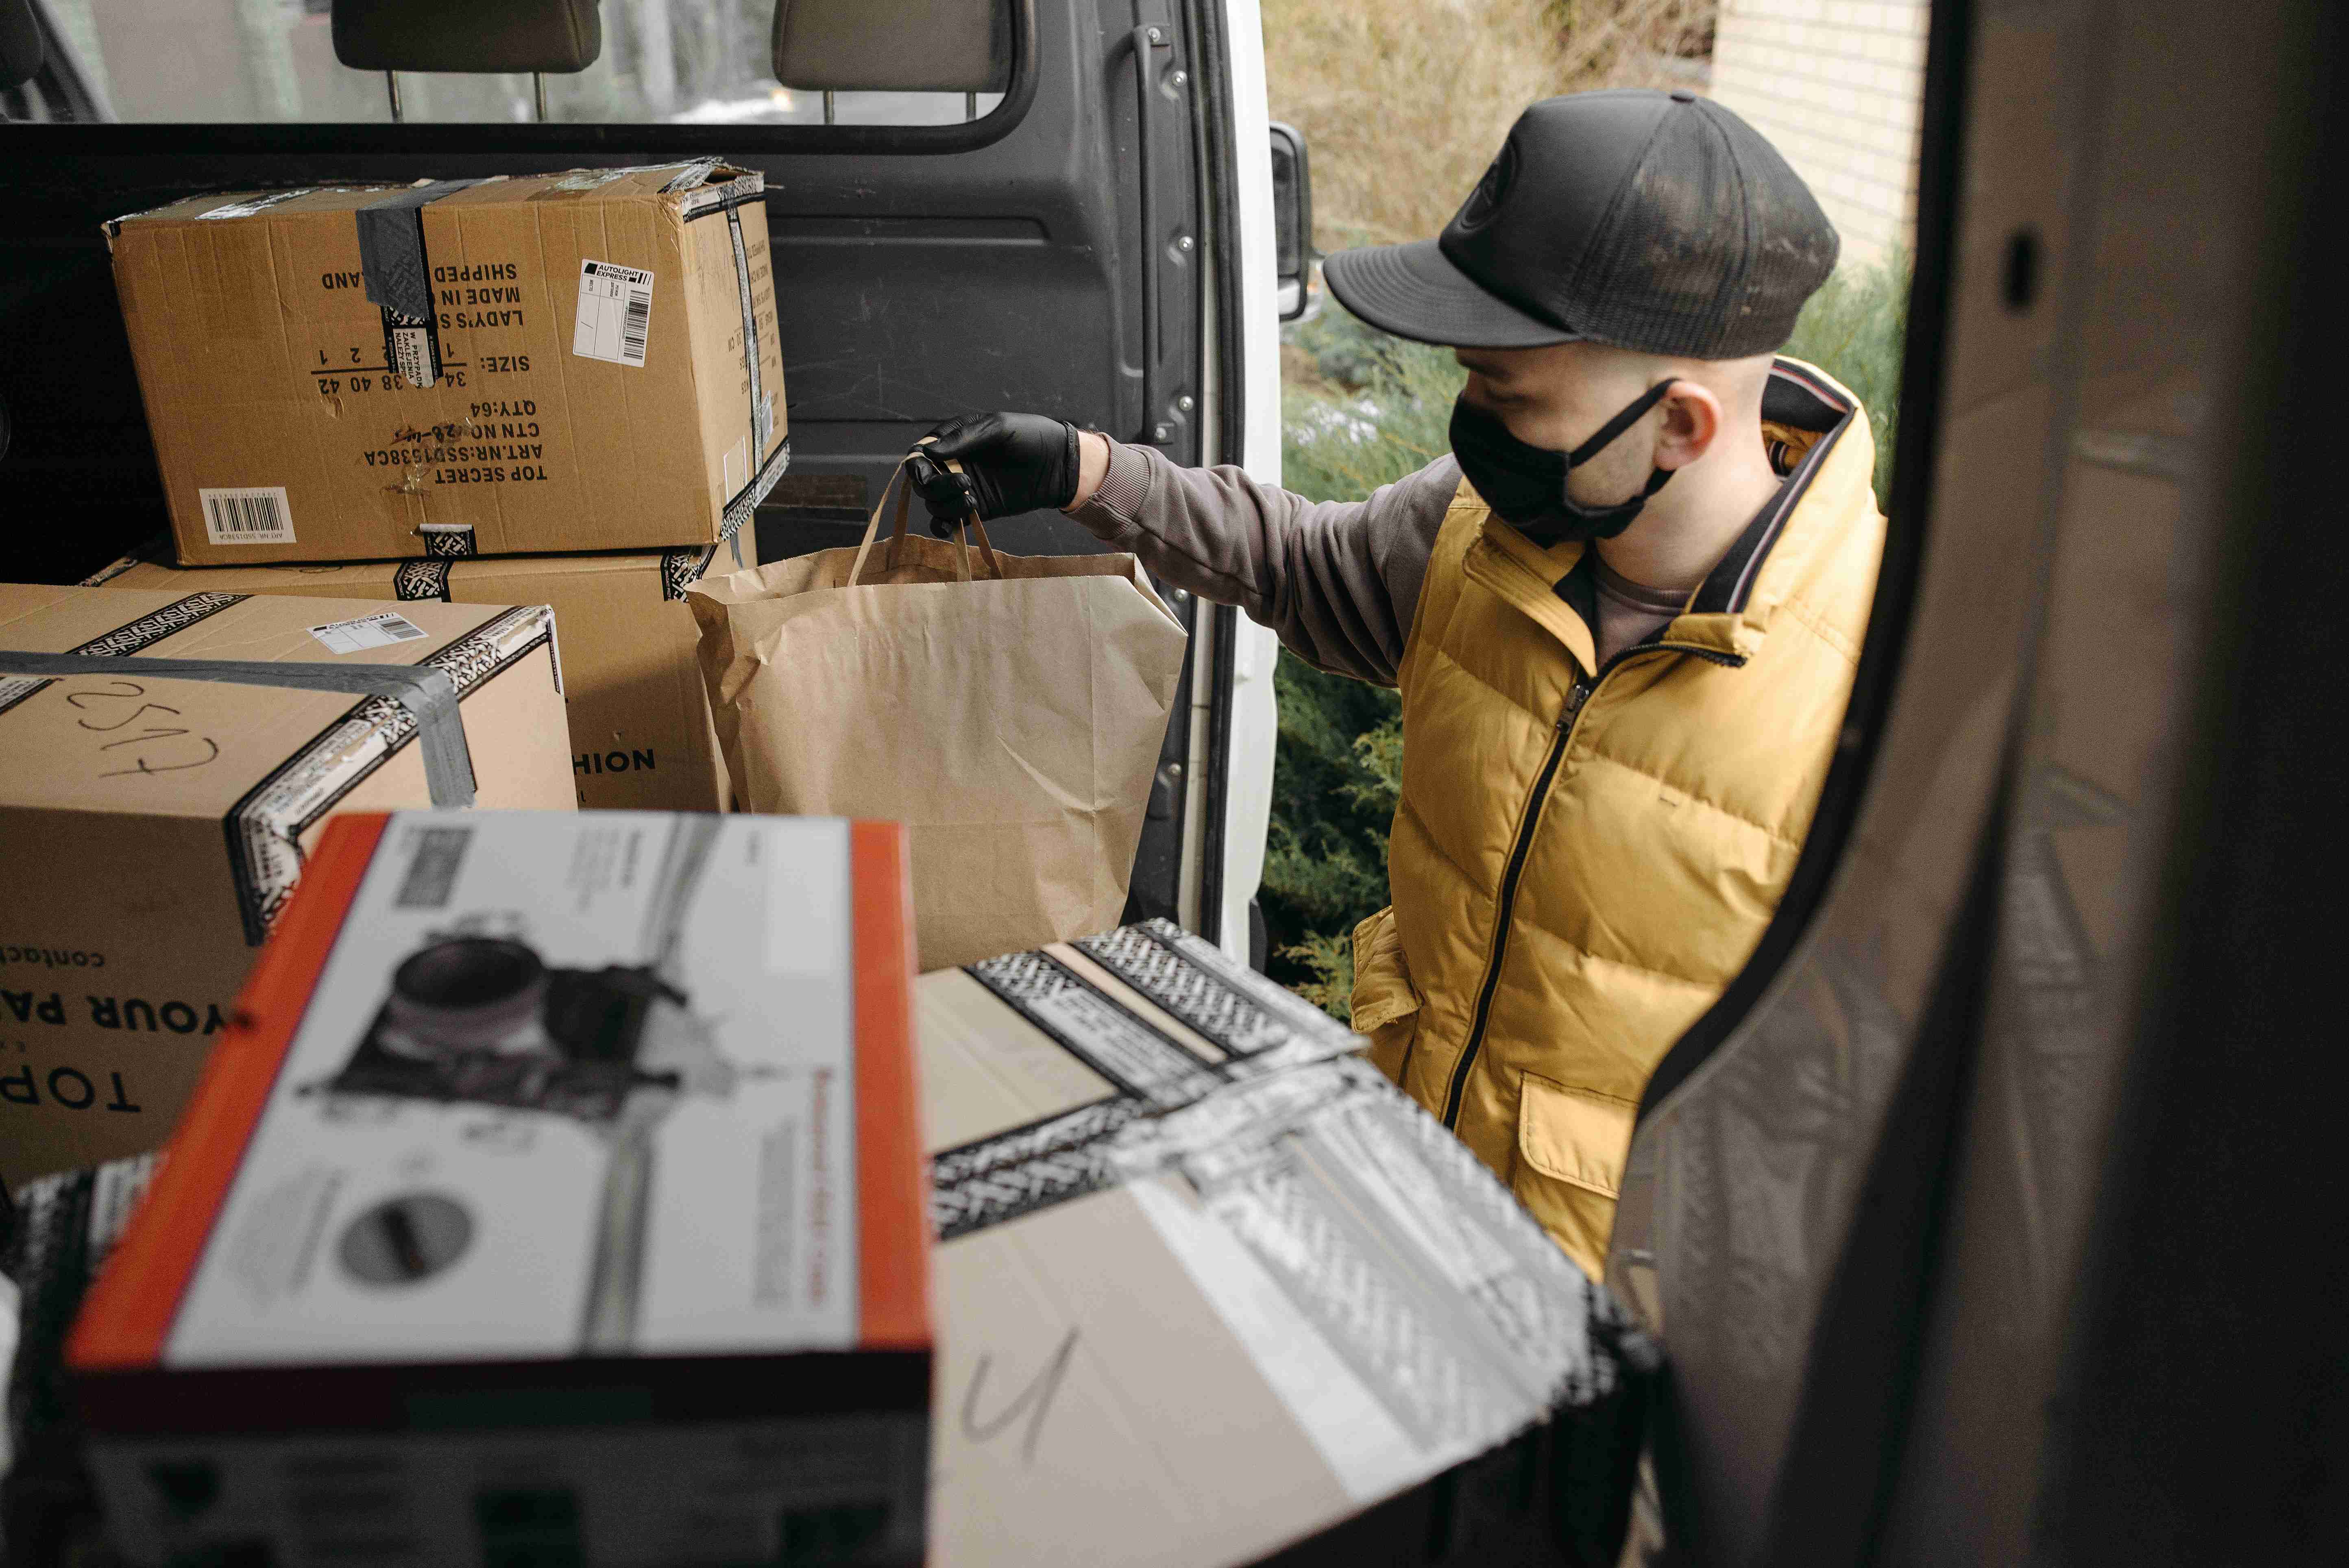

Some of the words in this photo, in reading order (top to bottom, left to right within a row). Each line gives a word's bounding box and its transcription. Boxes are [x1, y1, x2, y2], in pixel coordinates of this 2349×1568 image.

[435, 264, 516, 282] SHIPPED
[596, 270, 628, 281] EXPRESS
[599, 265, 639, 277] AUTOLIGHT
[322, 272, 363, 289] AND
[442, 290, 461, 306] IN
[468, 287, 521, 304] MADE
[456, 310, 523, 328] LADY'S
[319, 350, 328, 365] 1
[350, 348, 361, 364] 2
[402, 332, 414, 379] ZAKLEJENIA
[447, 343, 454, 357] 1
[480, 356, 530, 372] SIZE:
[318, 379, 340, 394] 42
[350, 377, 371, 392] 40
[381, 375, 404, 391] 38
[445, 371, 466, 388] 34
[471, 400, 536, 418] QTY:64
[503, 422, 540, 439] CTN
[364, 444, 543, 466] ART.NR:SSD1538CA
[435, 467, 505, 484] SECRET
[511, 465, 548, 481] TOP
[572, 749, 656, 775] HION
[86, 996, 227, 1035] YOUR
[0, 1065, 141, 1113] TOP
